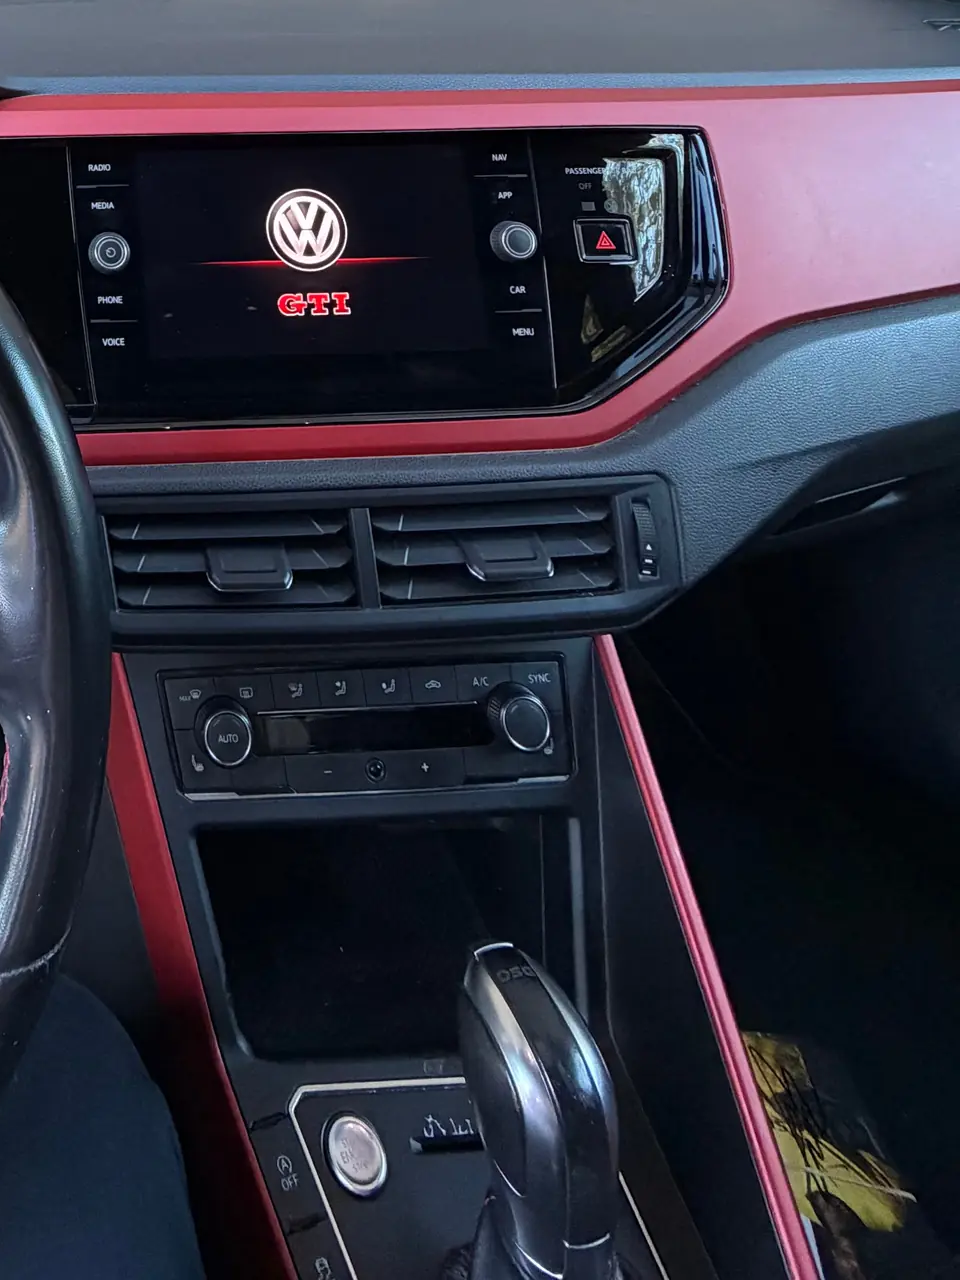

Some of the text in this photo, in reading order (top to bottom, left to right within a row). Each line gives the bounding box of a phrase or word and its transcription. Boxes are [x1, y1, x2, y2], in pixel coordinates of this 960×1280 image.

[510, 286, 526, 294] CAR
[98, 296, 123, 304] PHONE
[277, 292, 352, 316] GTI
[512, 328, 534, 336] MENU
[102, 338, 125, 346] VOICE
[472, 676, 489, 687] A/C
[528, 673, 551, 684] SYNC
[218, 734, 239, 743] AUTO
[280, 1173, 300, 1192] OFF
